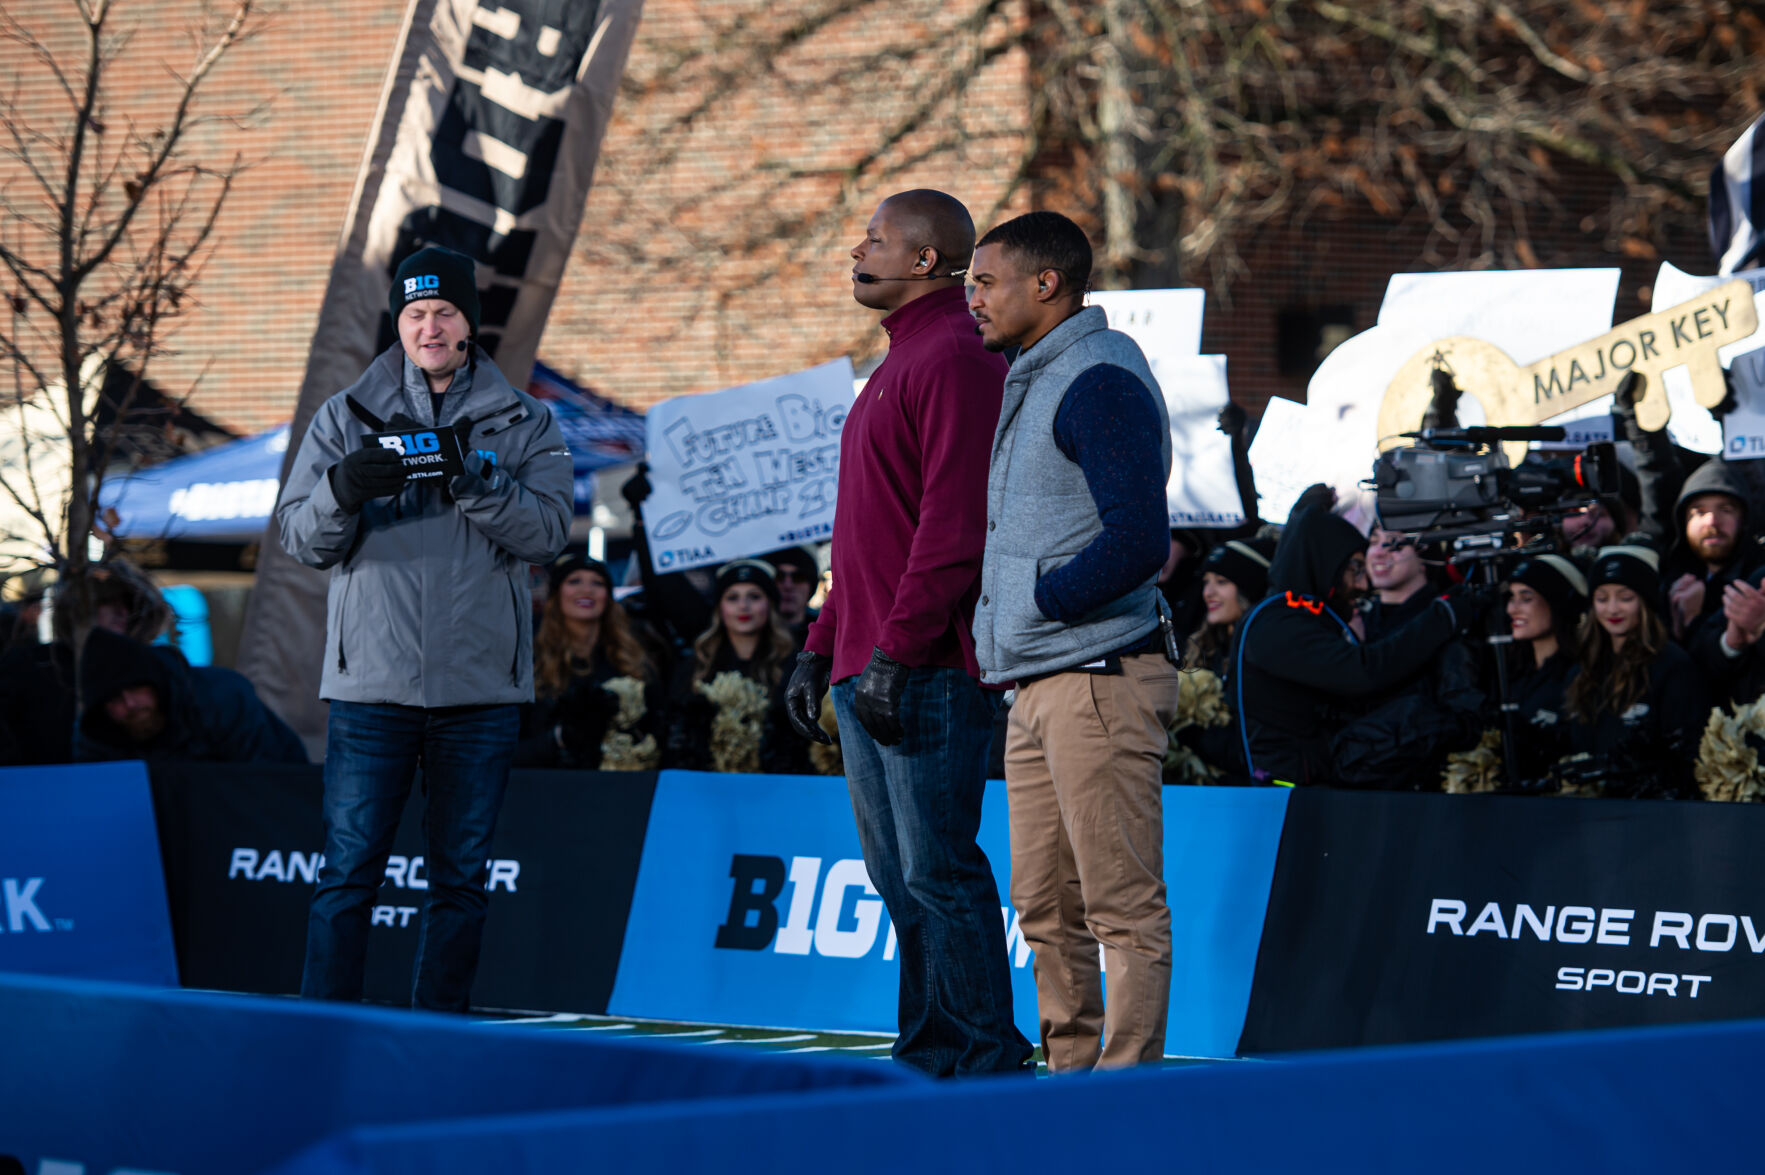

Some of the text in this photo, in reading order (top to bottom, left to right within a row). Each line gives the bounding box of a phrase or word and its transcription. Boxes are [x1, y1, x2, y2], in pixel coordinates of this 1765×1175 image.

[405, 289, 440, 300] NETWORK
[1533, 298, 1731, 404] MAJOR KEY
[401, 453, 444, 467] TWORK
[680, 443, 839, 502] TEN WEST
[695, 486, 793, 538] CHAMP
[676, 545, 716, 563] TIAA
[228, 847, 326, 884] RAN
[1426, 898, 1636, 946] RANGE
[1555, 966, 1712, 999] SPORT
